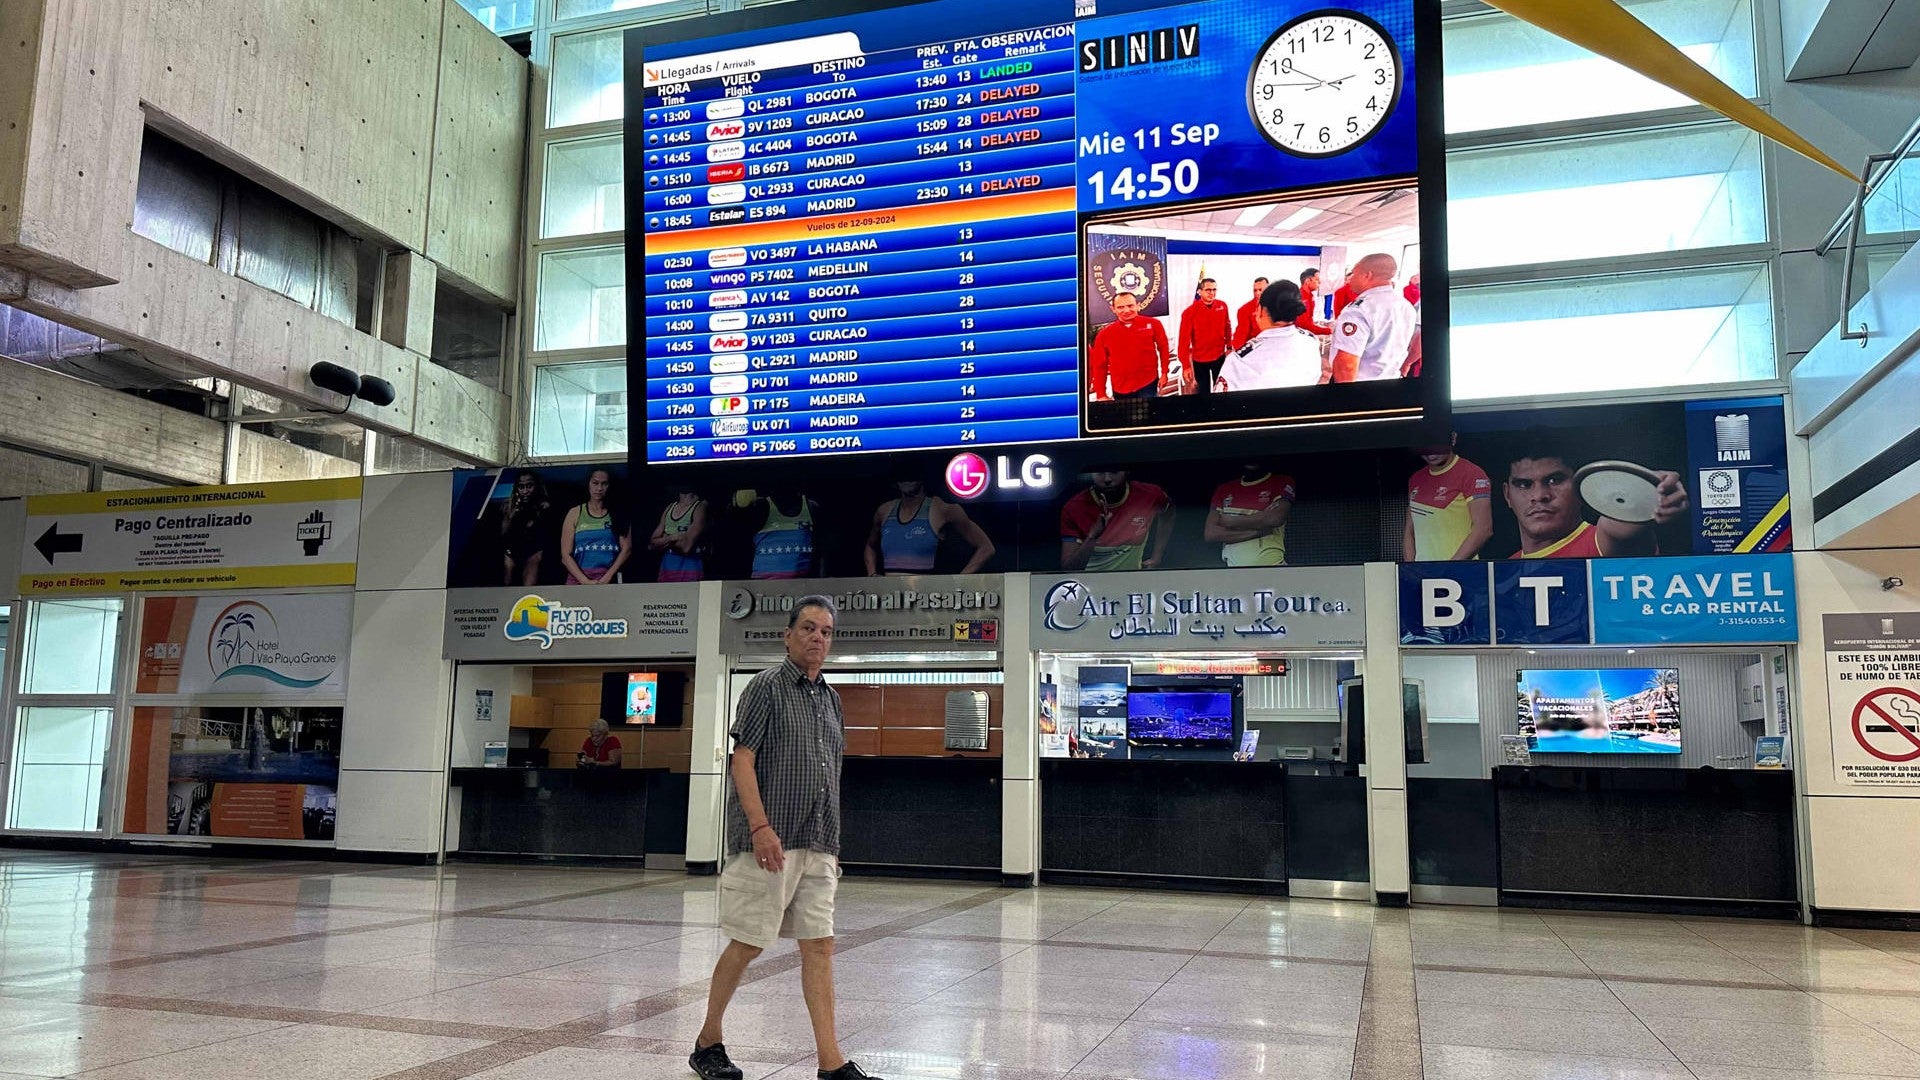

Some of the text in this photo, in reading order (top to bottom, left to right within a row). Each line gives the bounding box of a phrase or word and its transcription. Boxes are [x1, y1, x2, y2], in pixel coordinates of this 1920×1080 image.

[1075, 6, 1096, 17] IAIM
[658, 25, 1075, 96] HORA VUELO DESTINO PREV. PTA. OBSERVACION
[1083, 26, 1197, 70] SINIV
[661, 58, 755, 80] Llegadas Arrivals
[662, 42, 1046, 106] Time Flight To Est. Gate Remark
[663, 62, 1032, 122] 13:00 QL 2981 BOGOTA 13:40 13 LANDED
[663, 83, 1040, 143] 14:45 9V 1203 CURACAO 17:30 24 DELAYED
[664, 106, 1040, 164] 14:45 4C 4404 BOGOTA 15:09 28 DELAYED
[1079, 123, 1219, 157] Mie 11 Sep
[664, 129, 1040, 184] 15:10 IB 6673 MADRID 15:44 14 DELAYED
[664, 161, 972, 206] 16:00 QL 2933 CURACAO 13
[1088, 158, 1199, 204] 14:50
[664, 174, 1040, 226] 18:45 ES 894 MADRID 23:30 14 DELAYED
[807, 215, 896, 232] Vuelos de 12-09-2024
[664, 228, 972, 268] 02:30 VO 3497 LA HABANA 13
[665, 251, 973, 289] 10:08 P5 7402 MEDELLIN 14
[666, 296, 974, 331] 14:00 7A 9311 QUITO 28
[667, 385, 974, 414] 17:40 TP 175 MADEIRA 14
[666, 430, 975, 456] 20:36 P5 7066 BOGOTA 24
[1718, 449, 1750, 462] IAIM
[998, 454, 1052, 488] LG
[107, 490, 265, 507] ESTACIONAMIENTO INTERNACIONAL
[115, 513, 252, 533] Pago Centralizado
[299, 527, 319, 535] TICKET
[32, 579, 53, 588] Pago
[70, 577, 105, 586] Efectivo
[1603, 572, 1783, 600] TRAVEL
[756, 588, 998, 612] Infoción al Pasajero
[1079, 595, 1120, 616] Air
[1128, 593, 1153, 615] El
[1164, 592, 1242, 614] Sultan
[1253, 592, 1320, 613] Tour
[1422, 578, 1466, 626] B
[1520, 576, 1563, 626] T
[1642, 601, 1784, 615] & CAR RENTAL
[551, 610, 590, 622] FLY TO
[551, 622, 624, 635] LOS ROQUES
[1110, 616, 1286, 640] مكتب بيت السلطان
[1720, 617, 1785, 625] J-31540353-6
[257, 640, 278, 651] Hotel
[910, 627, 945, 637] Desk
[275, 653, 300, 666] Playa
[301, 652, 336, 663] Grande
